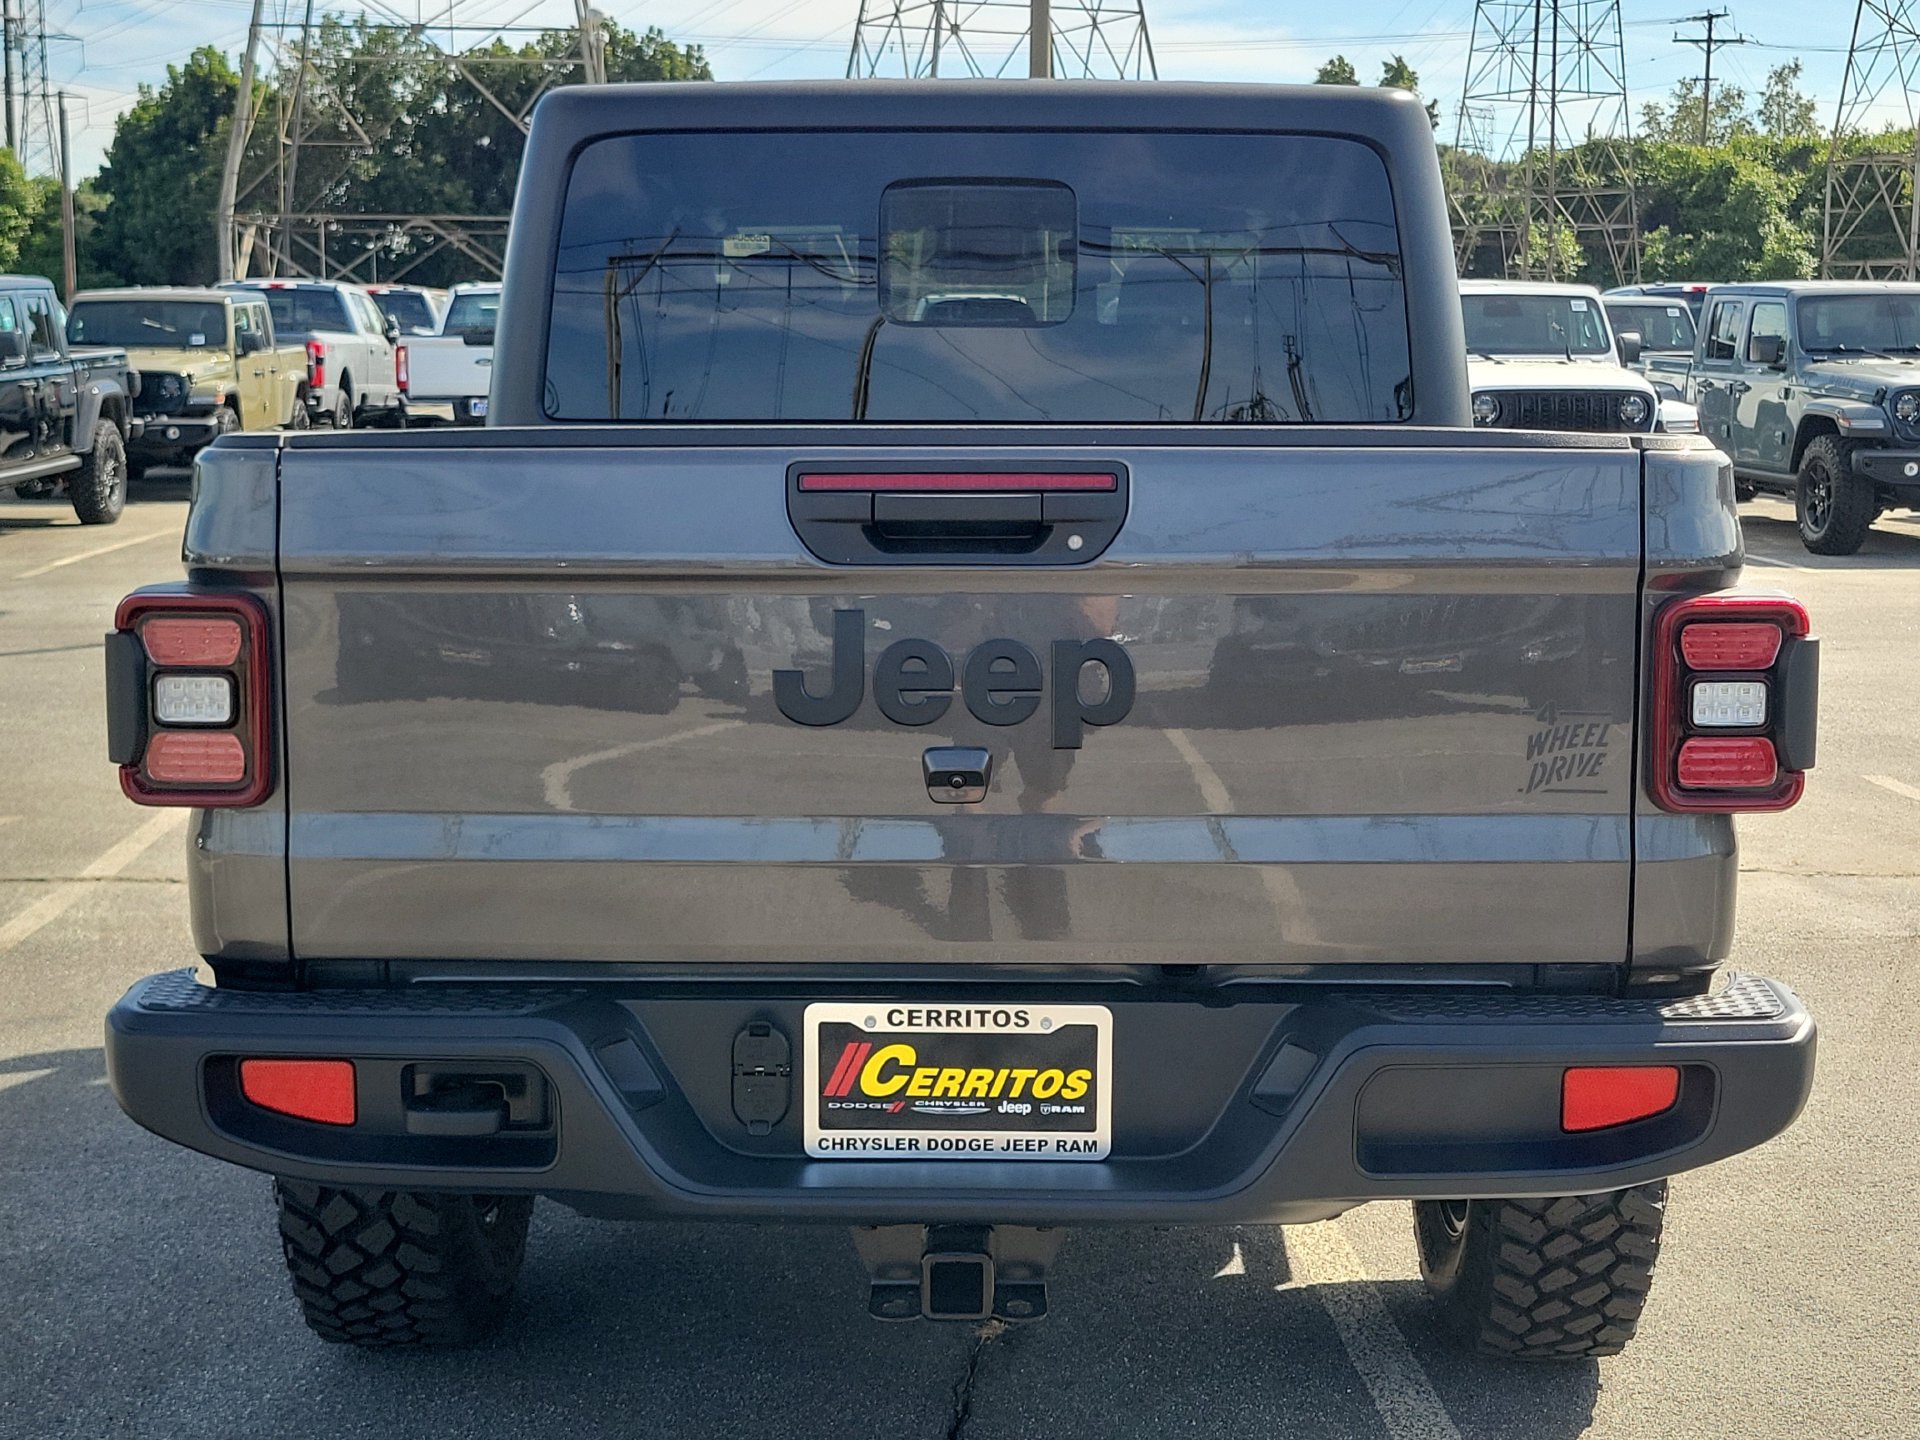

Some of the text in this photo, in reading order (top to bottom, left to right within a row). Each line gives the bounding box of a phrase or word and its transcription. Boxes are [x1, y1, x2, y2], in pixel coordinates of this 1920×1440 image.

[772, 609, 1136, 749] Jeep
[1536, 701, 1556, 725] 4
[1526, 723, 1611, 760] WHEEL
[1525, 753, 1607, 794] DRIVE
[886, 1008, 1030, 1028] CERRITOS
[860, 1043, 1093, 1100] CERRITOS
[828, 1102, 893, 1110] DODGE
[997, 1100, 1032, 1116] Jeep
[1051, 1105, 1085, 1114] RAM
[817, 1137, 1098, 1153] CHRYSLER DODGE JEEP RAM
